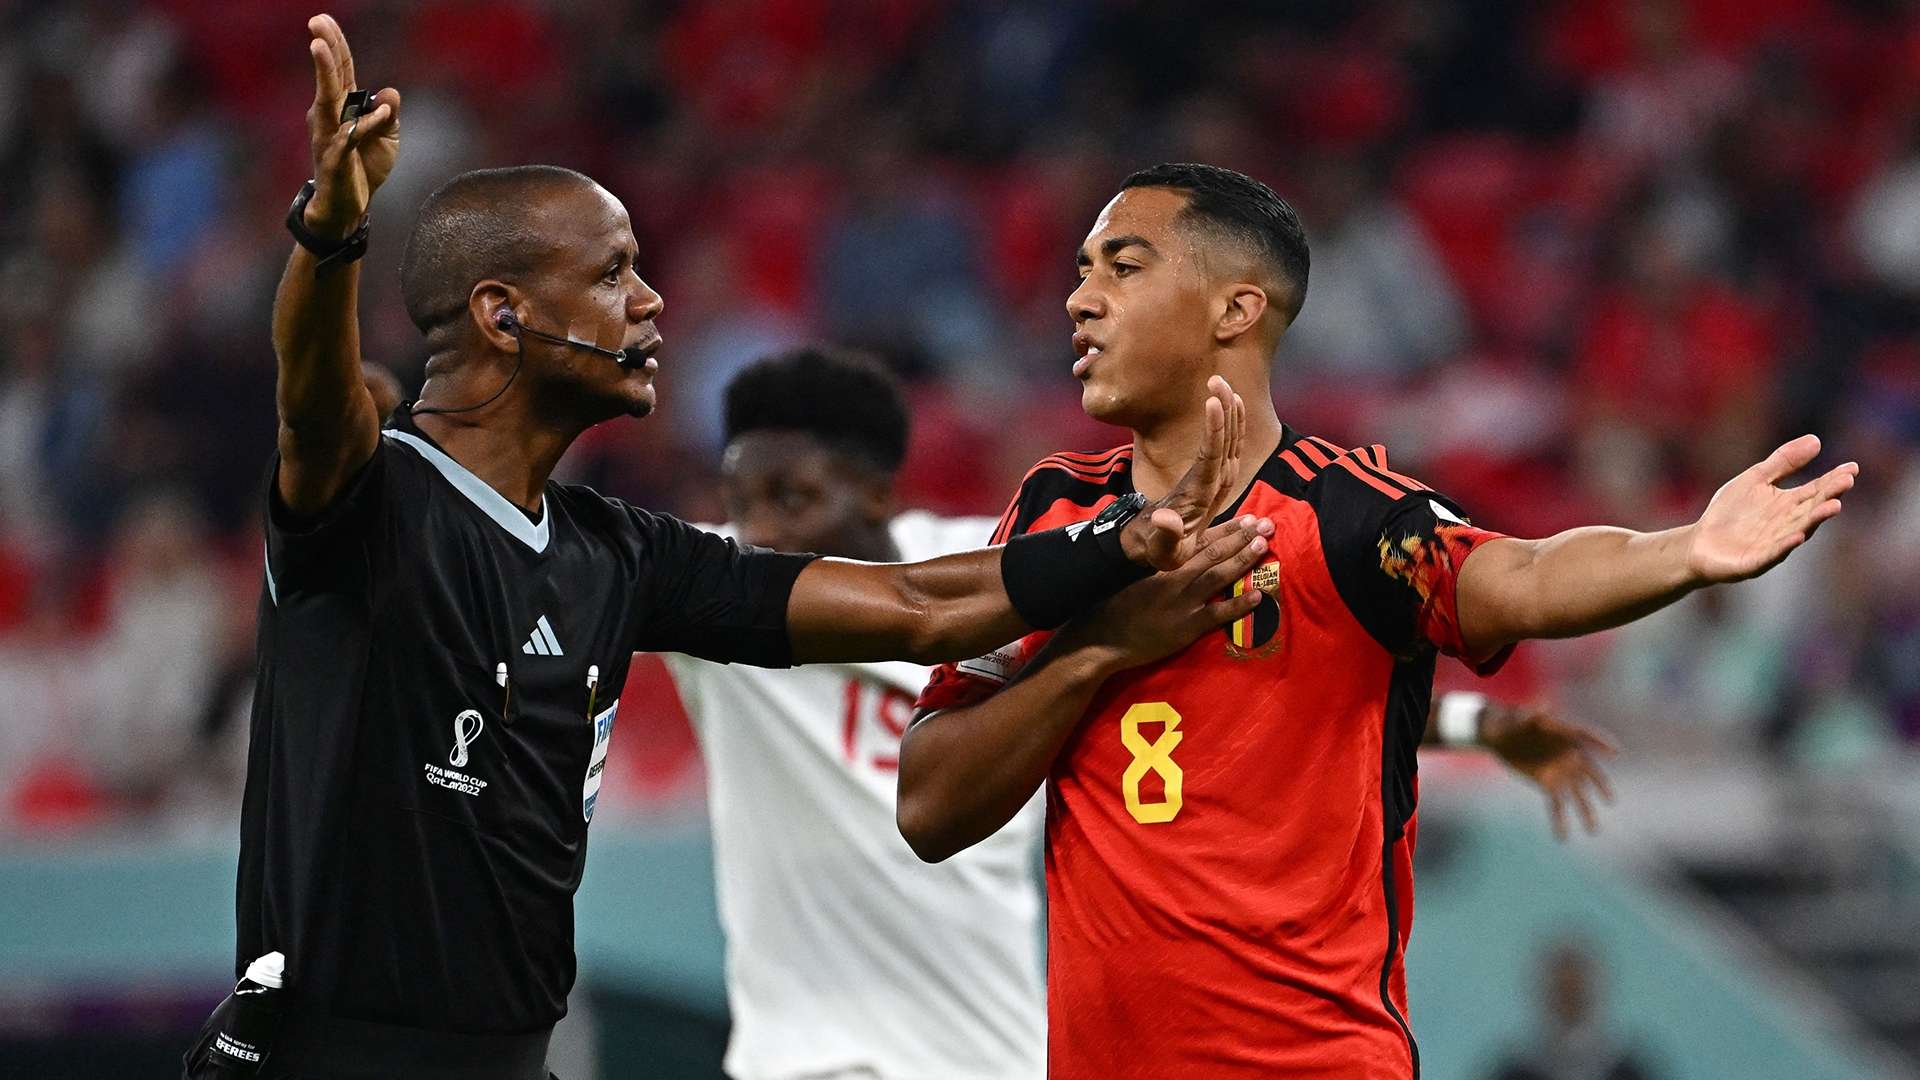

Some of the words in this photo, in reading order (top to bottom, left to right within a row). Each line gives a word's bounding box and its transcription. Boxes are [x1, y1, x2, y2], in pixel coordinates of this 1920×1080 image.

[1120, 701, 1184, 824] 8
[424, 763, 443, 777] FIFA
[444, 769, 470, 783] WORLD
[469, 777, 488, 789] CUP
[215, 1036, 261, 1062] EFEREES
